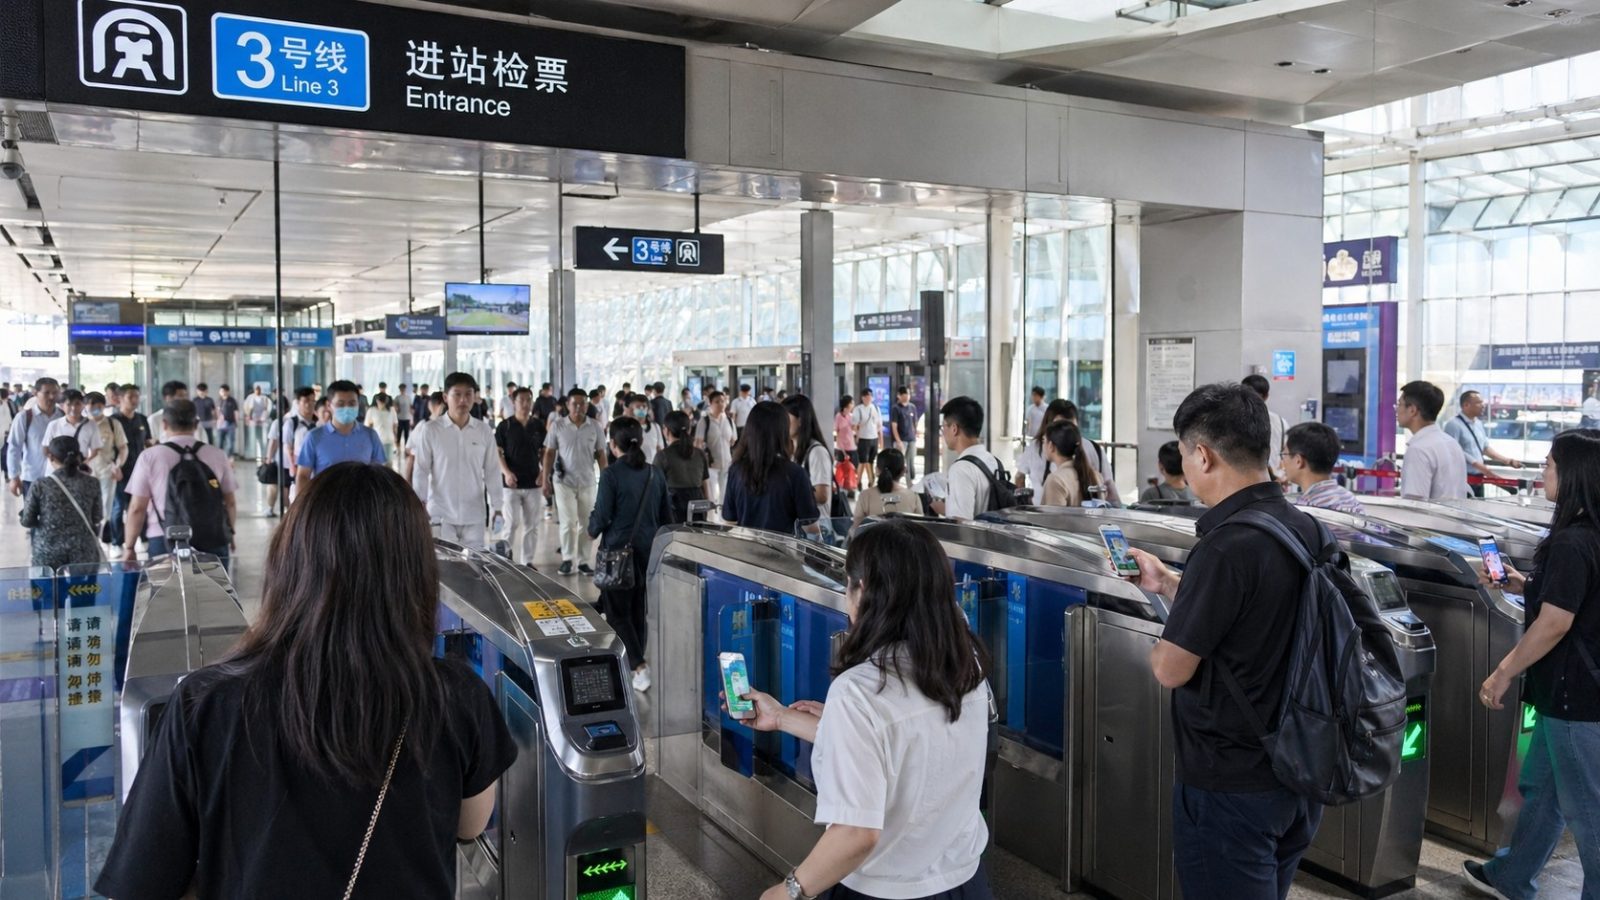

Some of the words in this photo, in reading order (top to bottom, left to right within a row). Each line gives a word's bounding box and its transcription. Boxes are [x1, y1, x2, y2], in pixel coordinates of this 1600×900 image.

[236, 31, 348, 89] 3号线
[405, 39, 569, 94] 进站检票
[281, 75, 322, 95] Line
[327, 79, 339, 96] 3
[406, 85, 511, 117] Entrance
